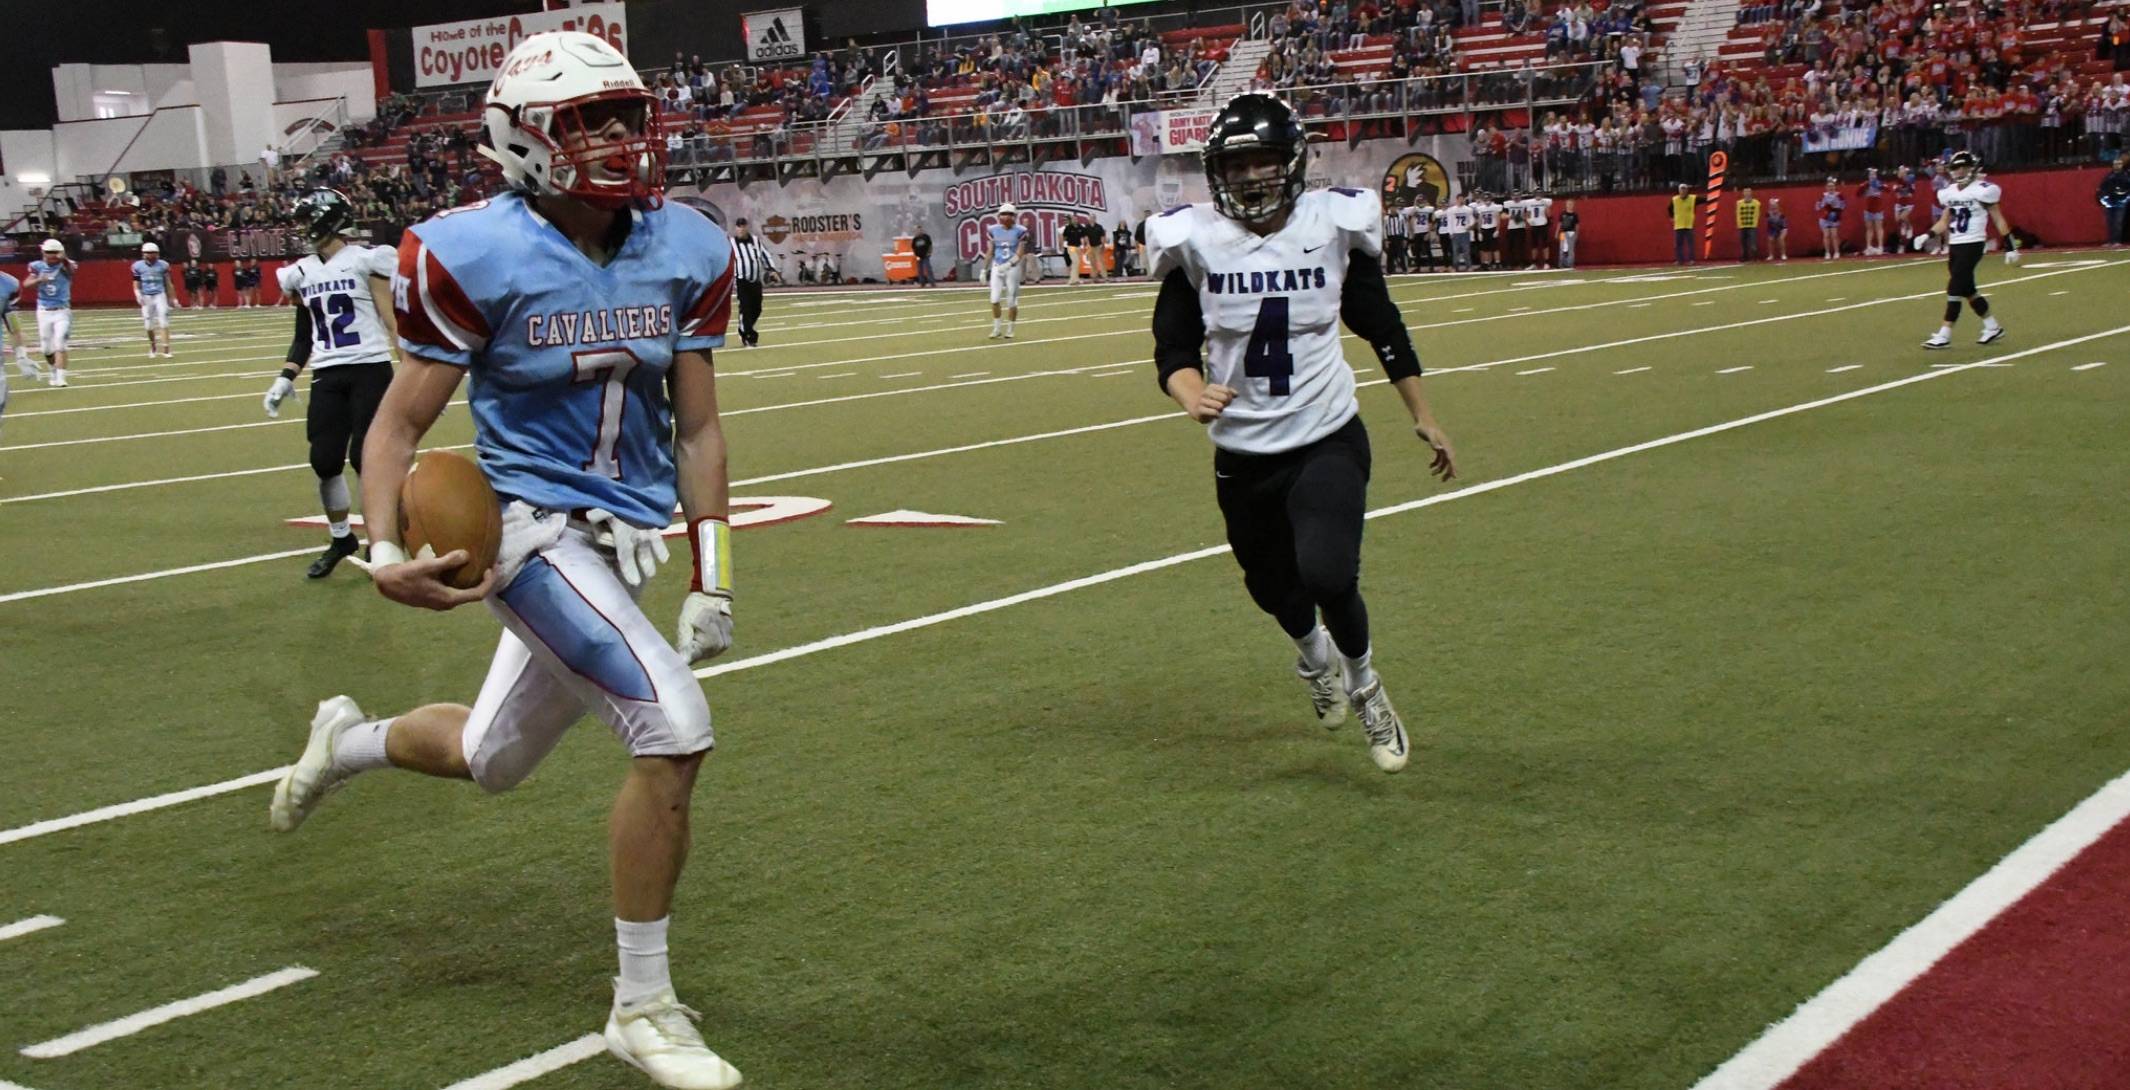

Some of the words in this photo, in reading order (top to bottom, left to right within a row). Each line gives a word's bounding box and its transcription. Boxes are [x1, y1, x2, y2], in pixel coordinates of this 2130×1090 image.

[430, 26, 466, 43] Home
[469, 23, 482, 38] of
[485, 21, 506, 37] the
[420, 41, 504, 82] Coyote
[756, 44, 799, 58] adidas
[602, 79, 636, 89] Riddell
[943, 172, 1015, 217] SOUTH
[1018, 171, 1108, 212] DAKOTA
[791, 213, 862, 234] ROOSTER'S
[300, 278, 356, 299] WILDKATS
[1206, 266, 1326, 295] WILDKATS
[527, 304, 671, 347] CAVALIERS
[1243, 296, 1295, 396] 4
[571, 346, 642, 481] 7
